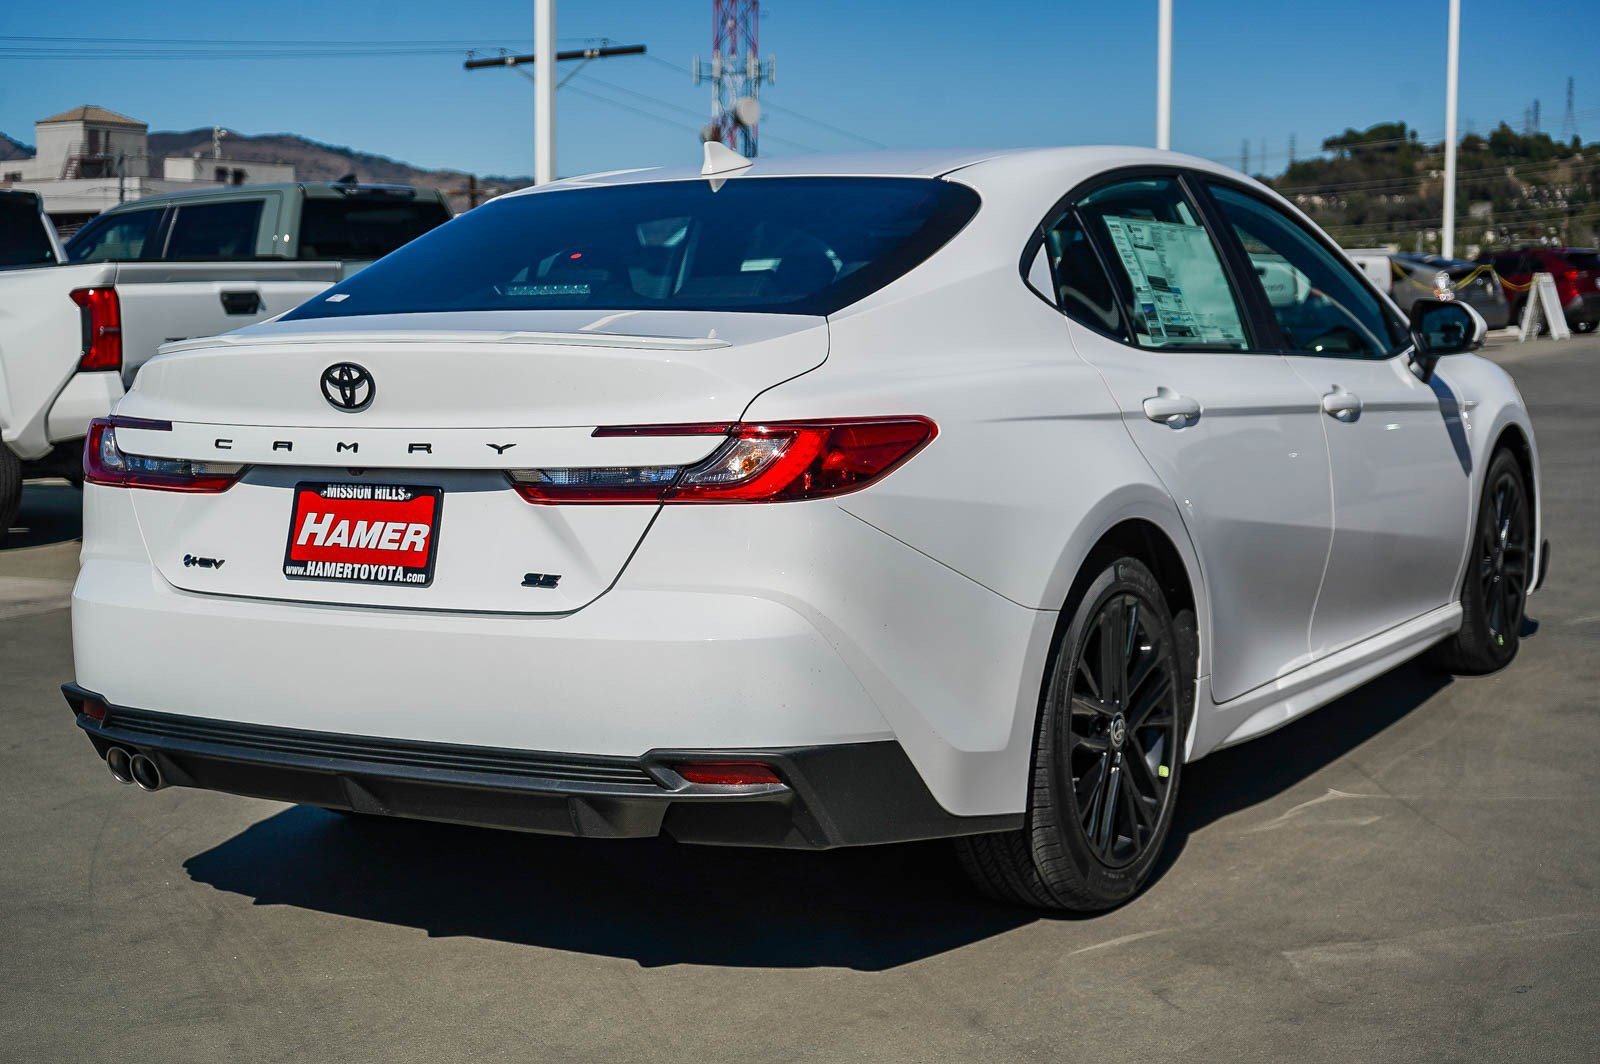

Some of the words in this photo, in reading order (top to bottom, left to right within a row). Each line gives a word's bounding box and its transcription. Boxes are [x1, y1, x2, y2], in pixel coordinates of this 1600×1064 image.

[214, 438, 518, 455] CAMRY
[327, 484, 371, 500] MISSION
[374, 485, 406, 501] HILLS
[296, 512, 431, 552] HAMER
[285, 561, 426, 584] www.HAMERTOYOTA.com
[520, 572, 562, 590] SE
